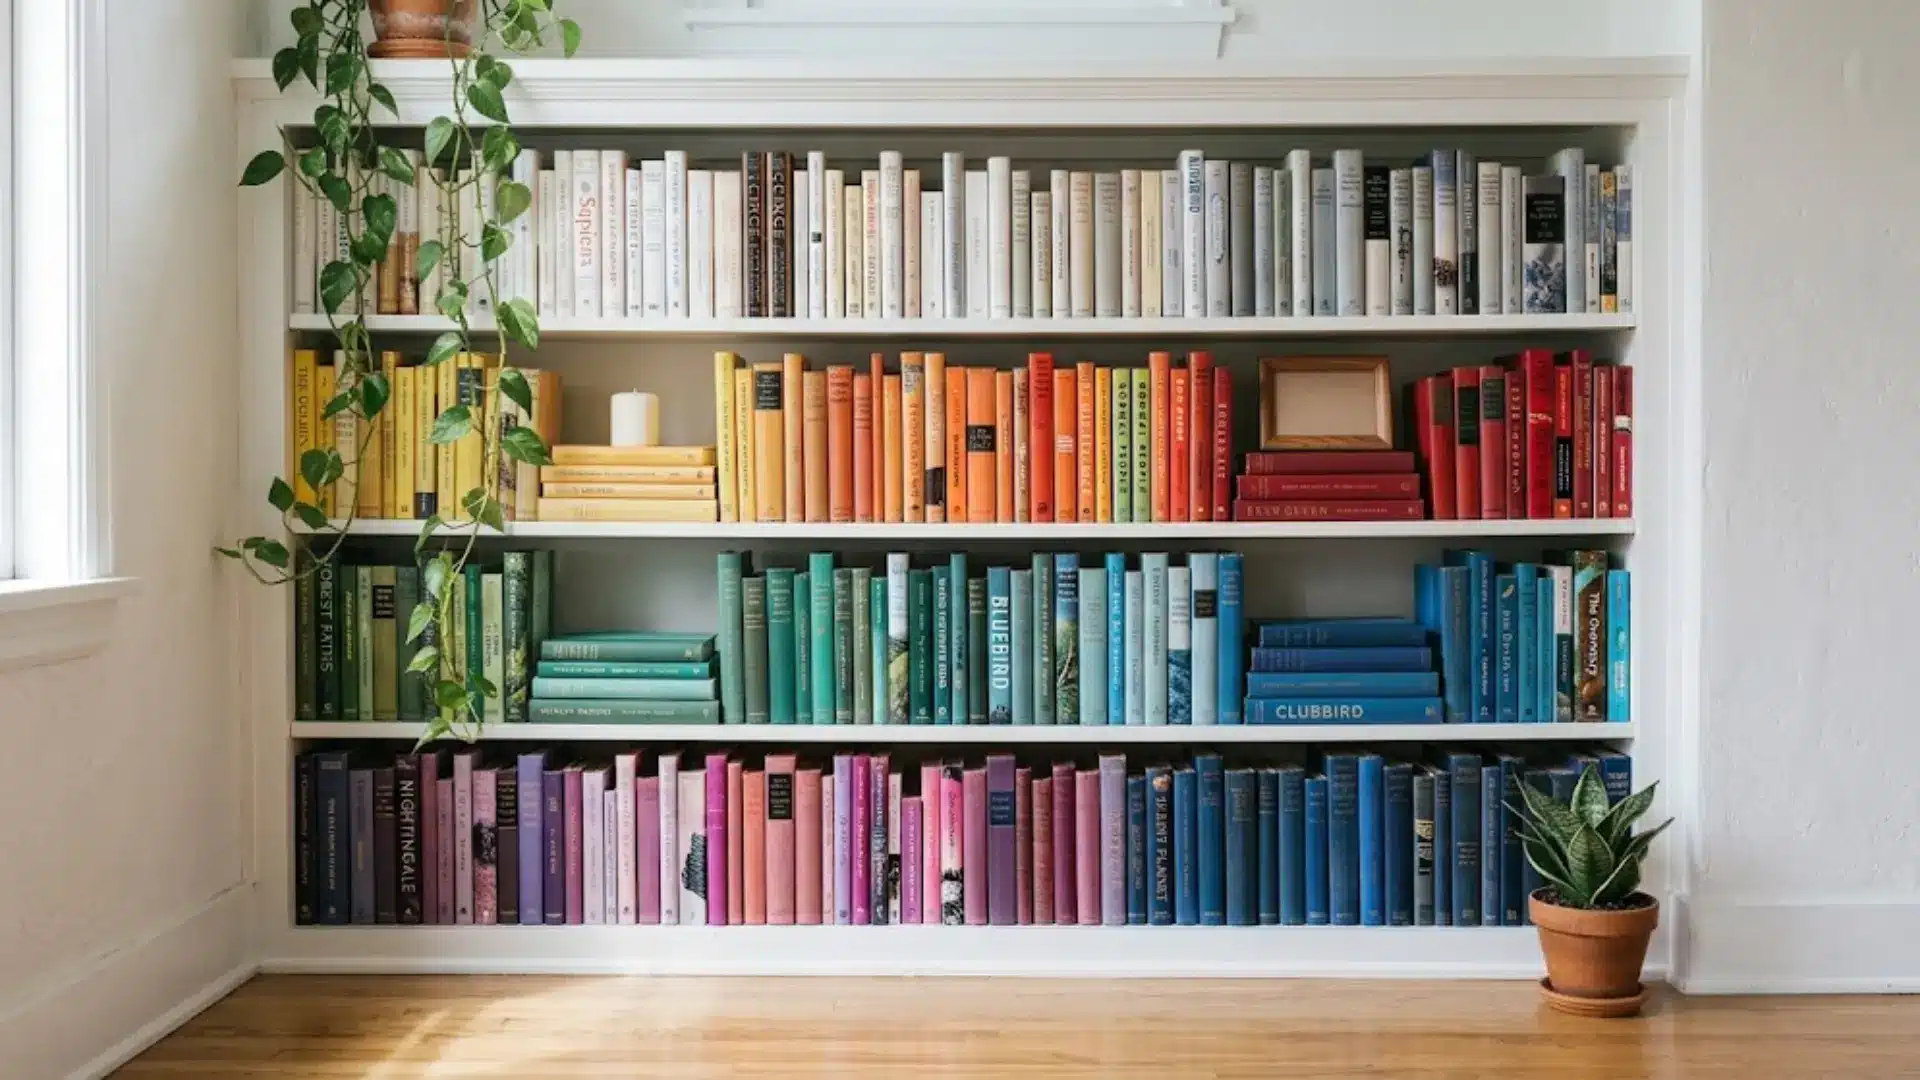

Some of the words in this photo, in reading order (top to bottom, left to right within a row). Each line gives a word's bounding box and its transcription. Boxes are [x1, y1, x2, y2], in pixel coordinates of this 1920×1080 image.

[991, 596, 1009, 689] BLUEBIRD
[1275, 704, 1364, 719] CLUBBIRD
[399, 780, 416, 893] NIGHTINGALE
